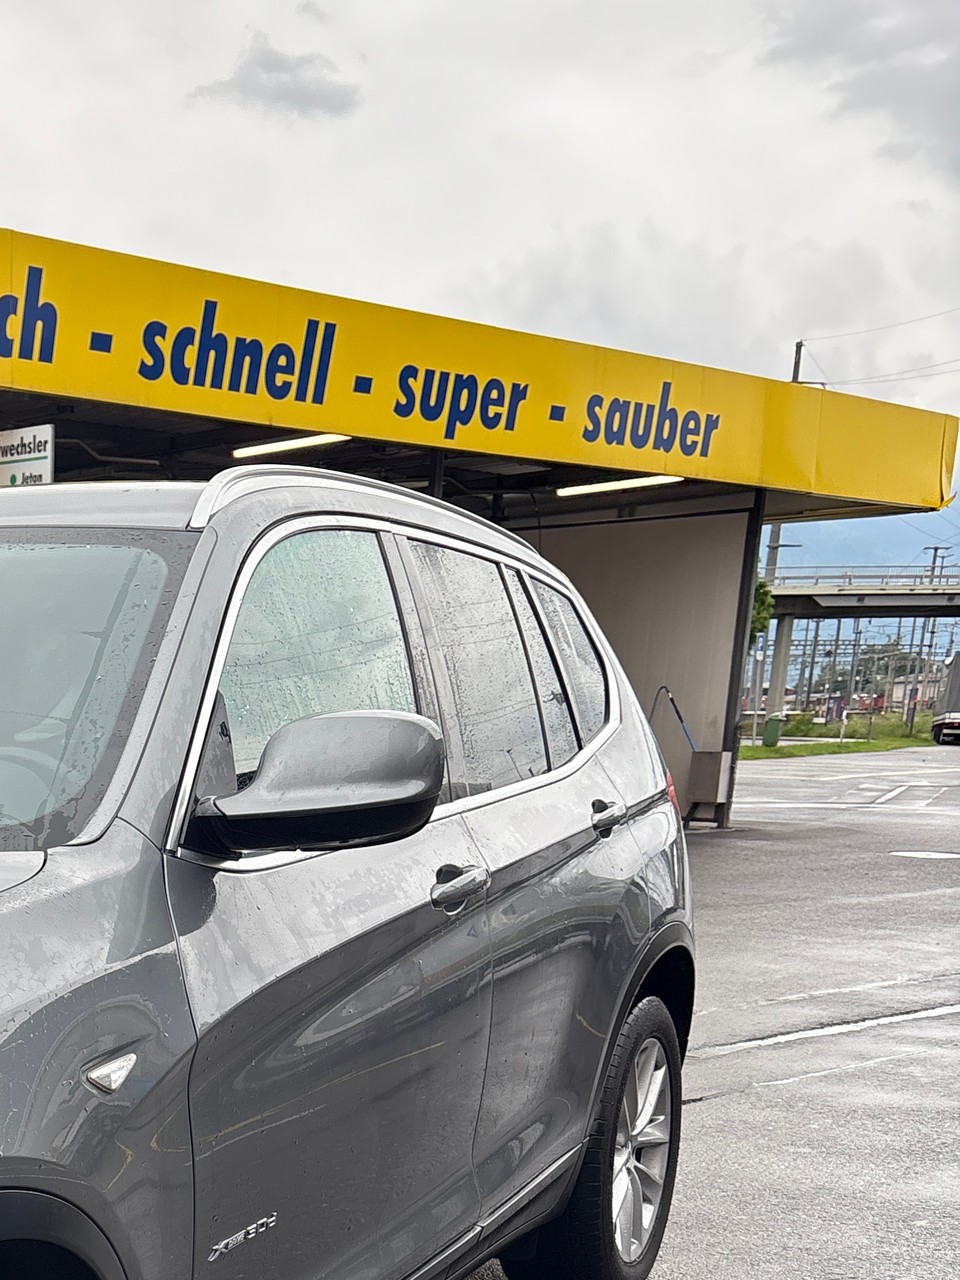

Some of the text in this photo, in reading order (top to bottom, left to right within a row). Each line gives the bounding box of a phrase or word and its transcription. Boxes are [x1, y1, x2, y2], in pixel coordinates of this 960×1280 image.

[138, 299, 337, 405] schnell
[393, 363, 529, 440] super
[582, 382, 721, 457] sauber
